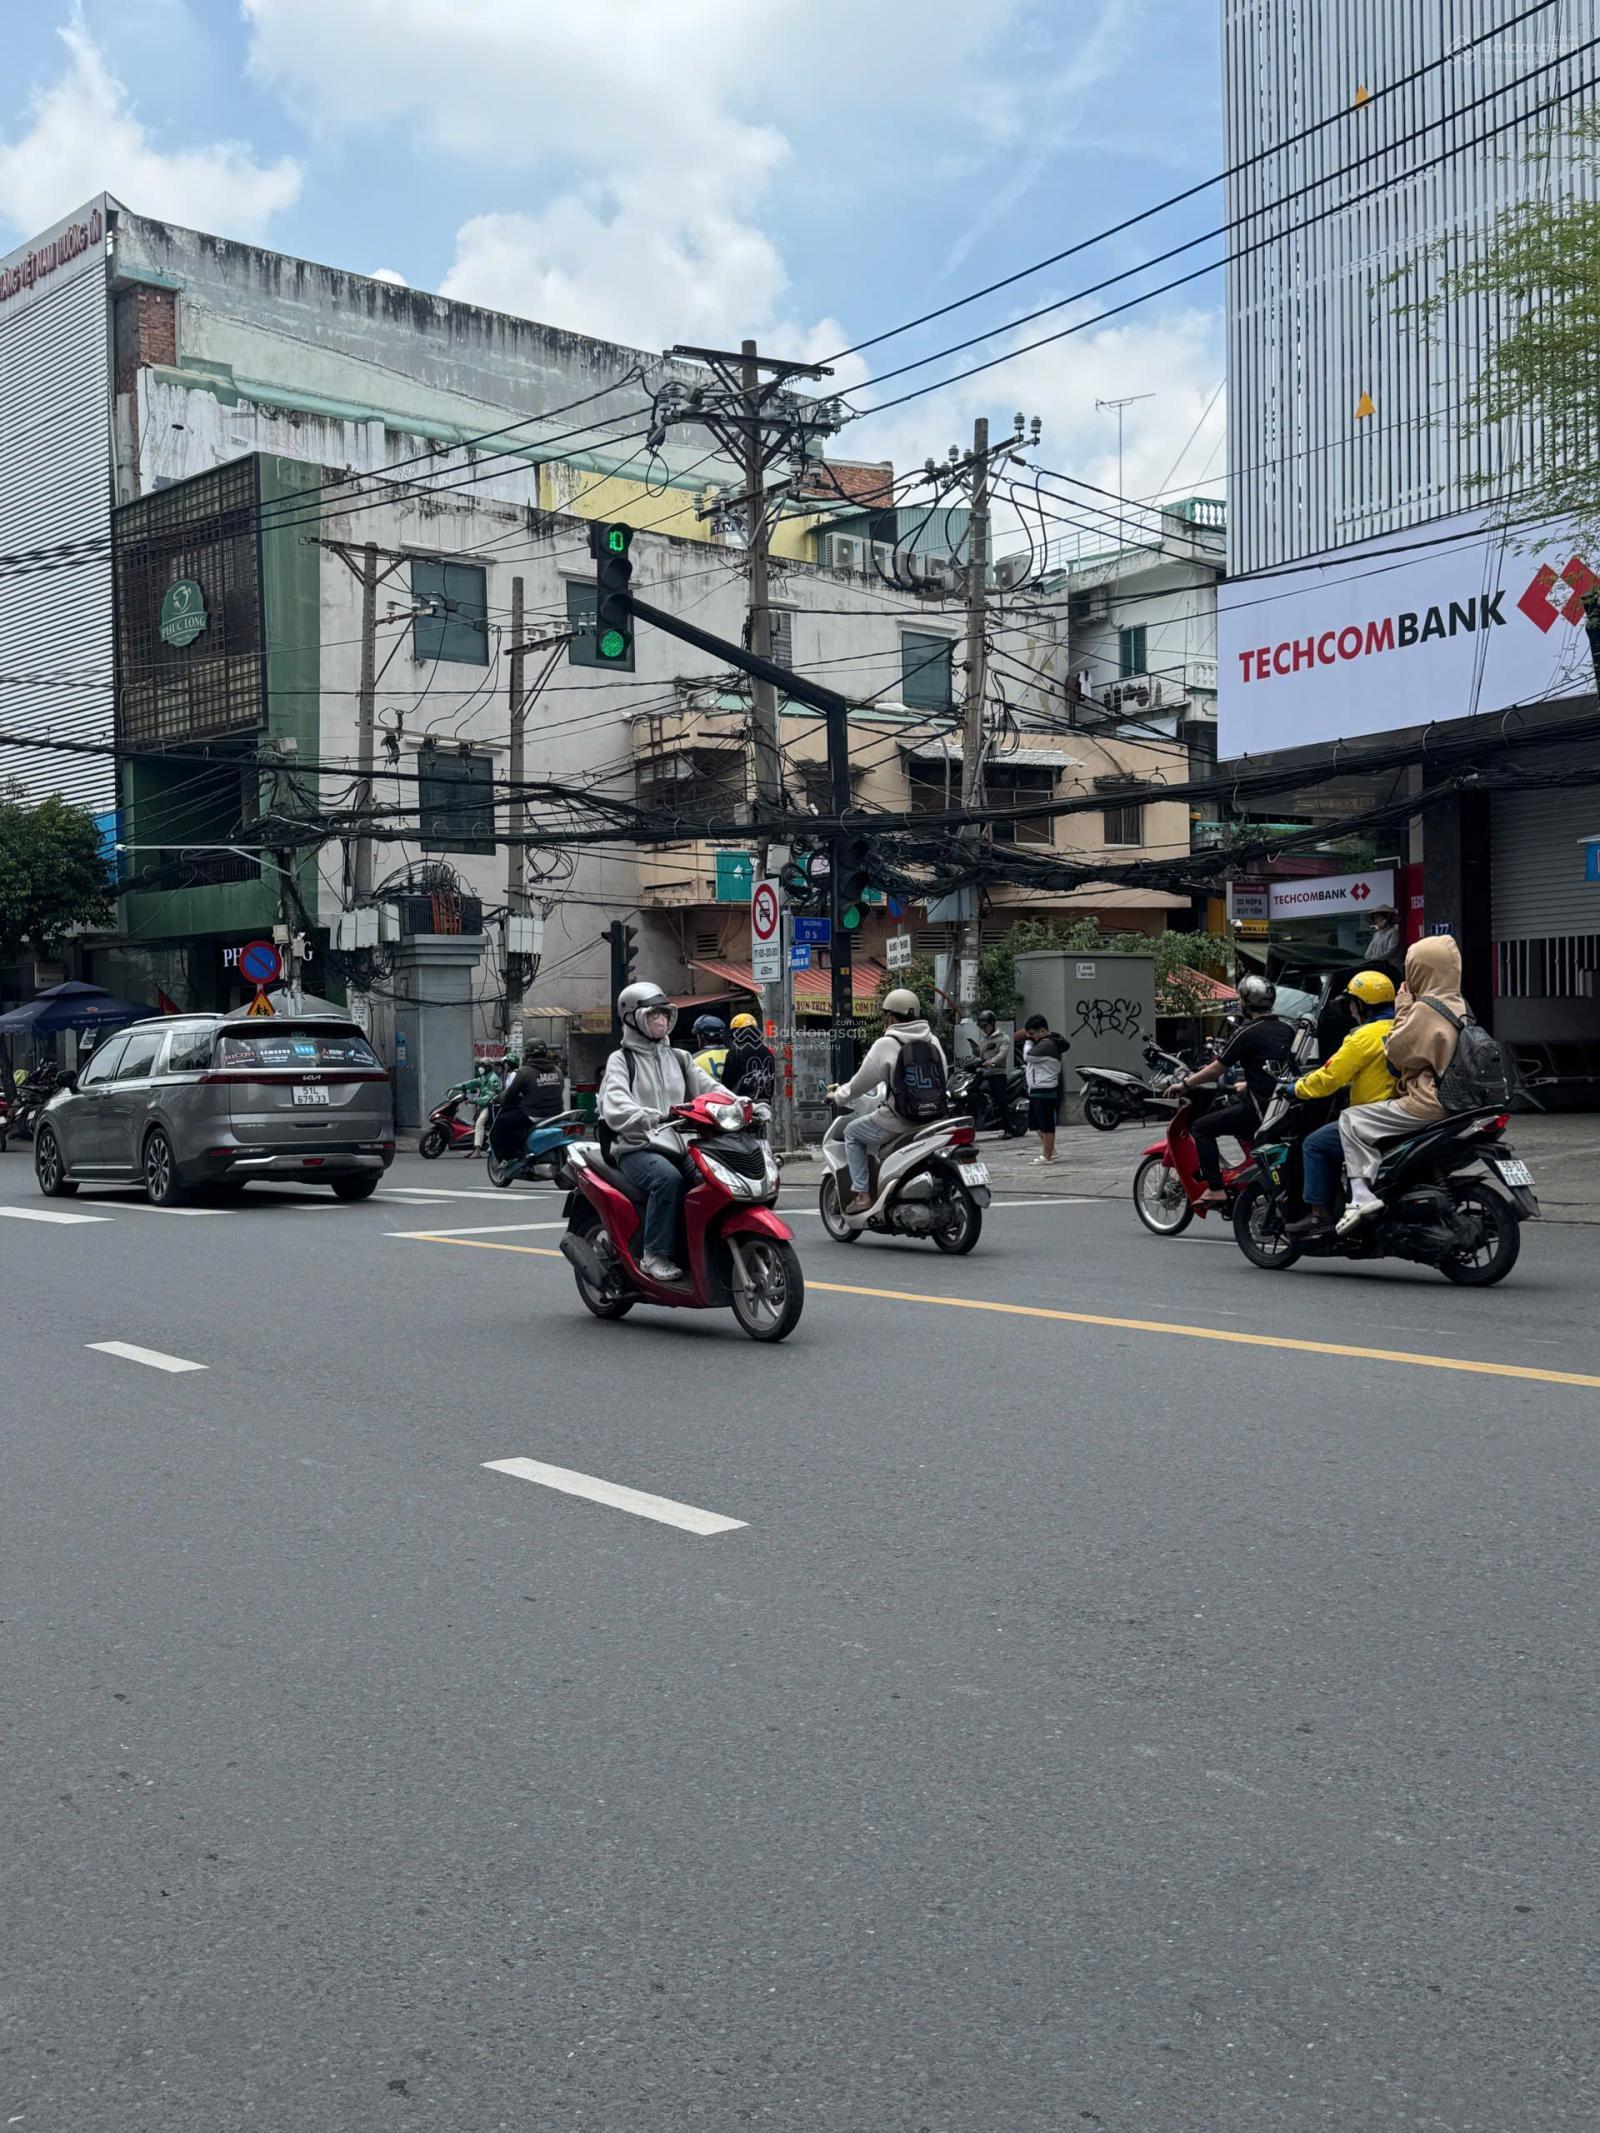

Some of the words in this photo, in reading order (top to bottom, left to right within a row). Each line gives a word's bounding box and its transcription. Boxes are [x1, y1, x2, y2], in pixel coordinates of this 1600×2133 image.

[184, 615, 205, 629] LONG
[1238, 590, 1507, 682] TECHCOMBANK
[1273, 888, 1347, 905] TECHCOMBANK
[303, 1086, 319, 1095] 51L
